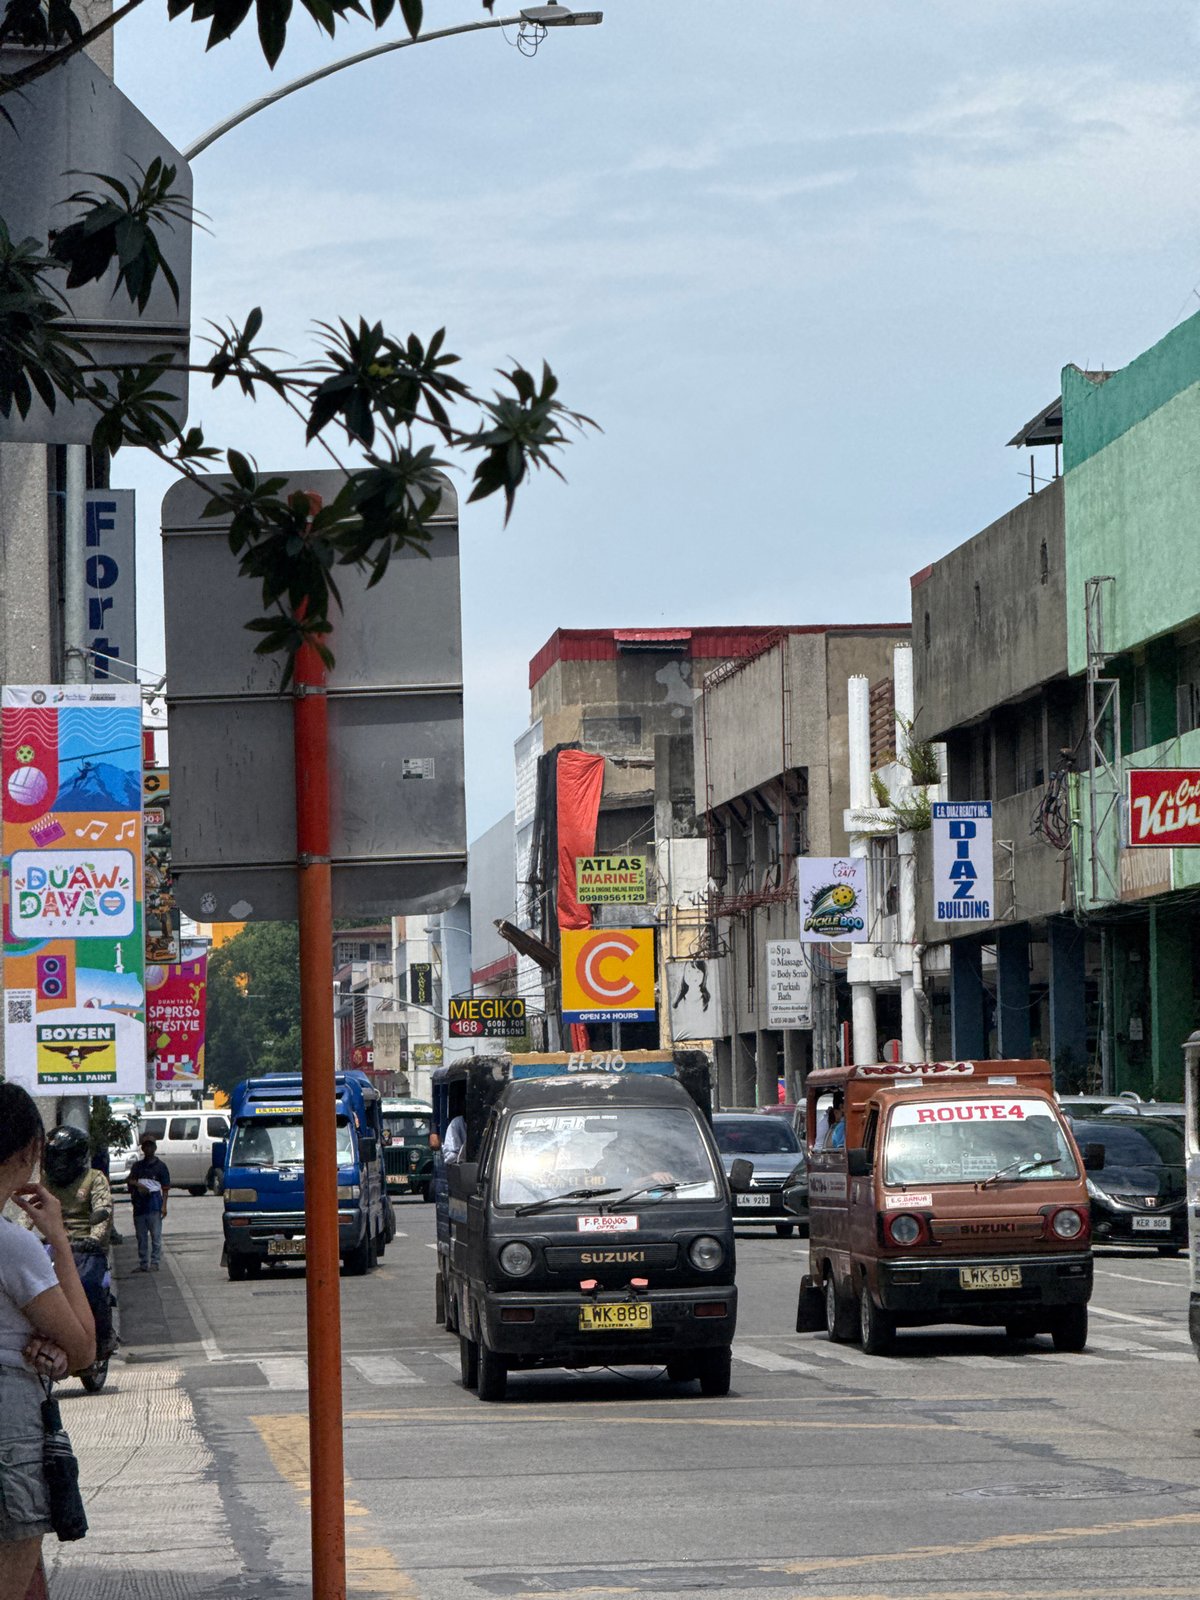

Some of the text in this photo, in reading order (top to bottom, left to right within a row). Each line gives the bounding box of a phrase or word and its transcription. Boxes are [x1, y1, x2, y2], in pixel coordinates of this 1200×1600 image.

[946, 805, 959, 817] DIAZ
[959, 805, 977, 817] REALTY
[1133, 790, 1200, 839] Kin
[582, 858, 642, 871] ATLAS
[949, 820, 978, 900] DIAZ
[26, 865, 120, 890] DUAW
[581, 872, 638, 884] MARINE
[837, 869, 857, 878] 24/7
[19, 890, 126, 919] DAVAO
[937, 900, 990, 919] BUILDING
[804, 916, 864, 932] PICKLE BOO
[776, 945, 791, 956] Spa
[777, 958, 803, 968] Massage
[777, 968, 808, 980] Body Scrub
[777, 982, 801, 991] Turkish
[778, 991, 792, 1001] Bath
[148, 1004, 193, 1018] SPORTS
[450, 1000, 524, 1020] MEGIKO
[601, 1012, 611, 1020] 24
[455, 1020, 478, 1033] 168
[486, 1020, 507, 1028] GOOD
[484, 1028, 489, 1036] 2
[41, 1027, 111, 1041] BOYSEN
[960, 1223, 1016, 1234] SUZUKI
[1136, 1218, 1150, 1228] KER
[581, 1251, 645, 1264] SUZUKI
